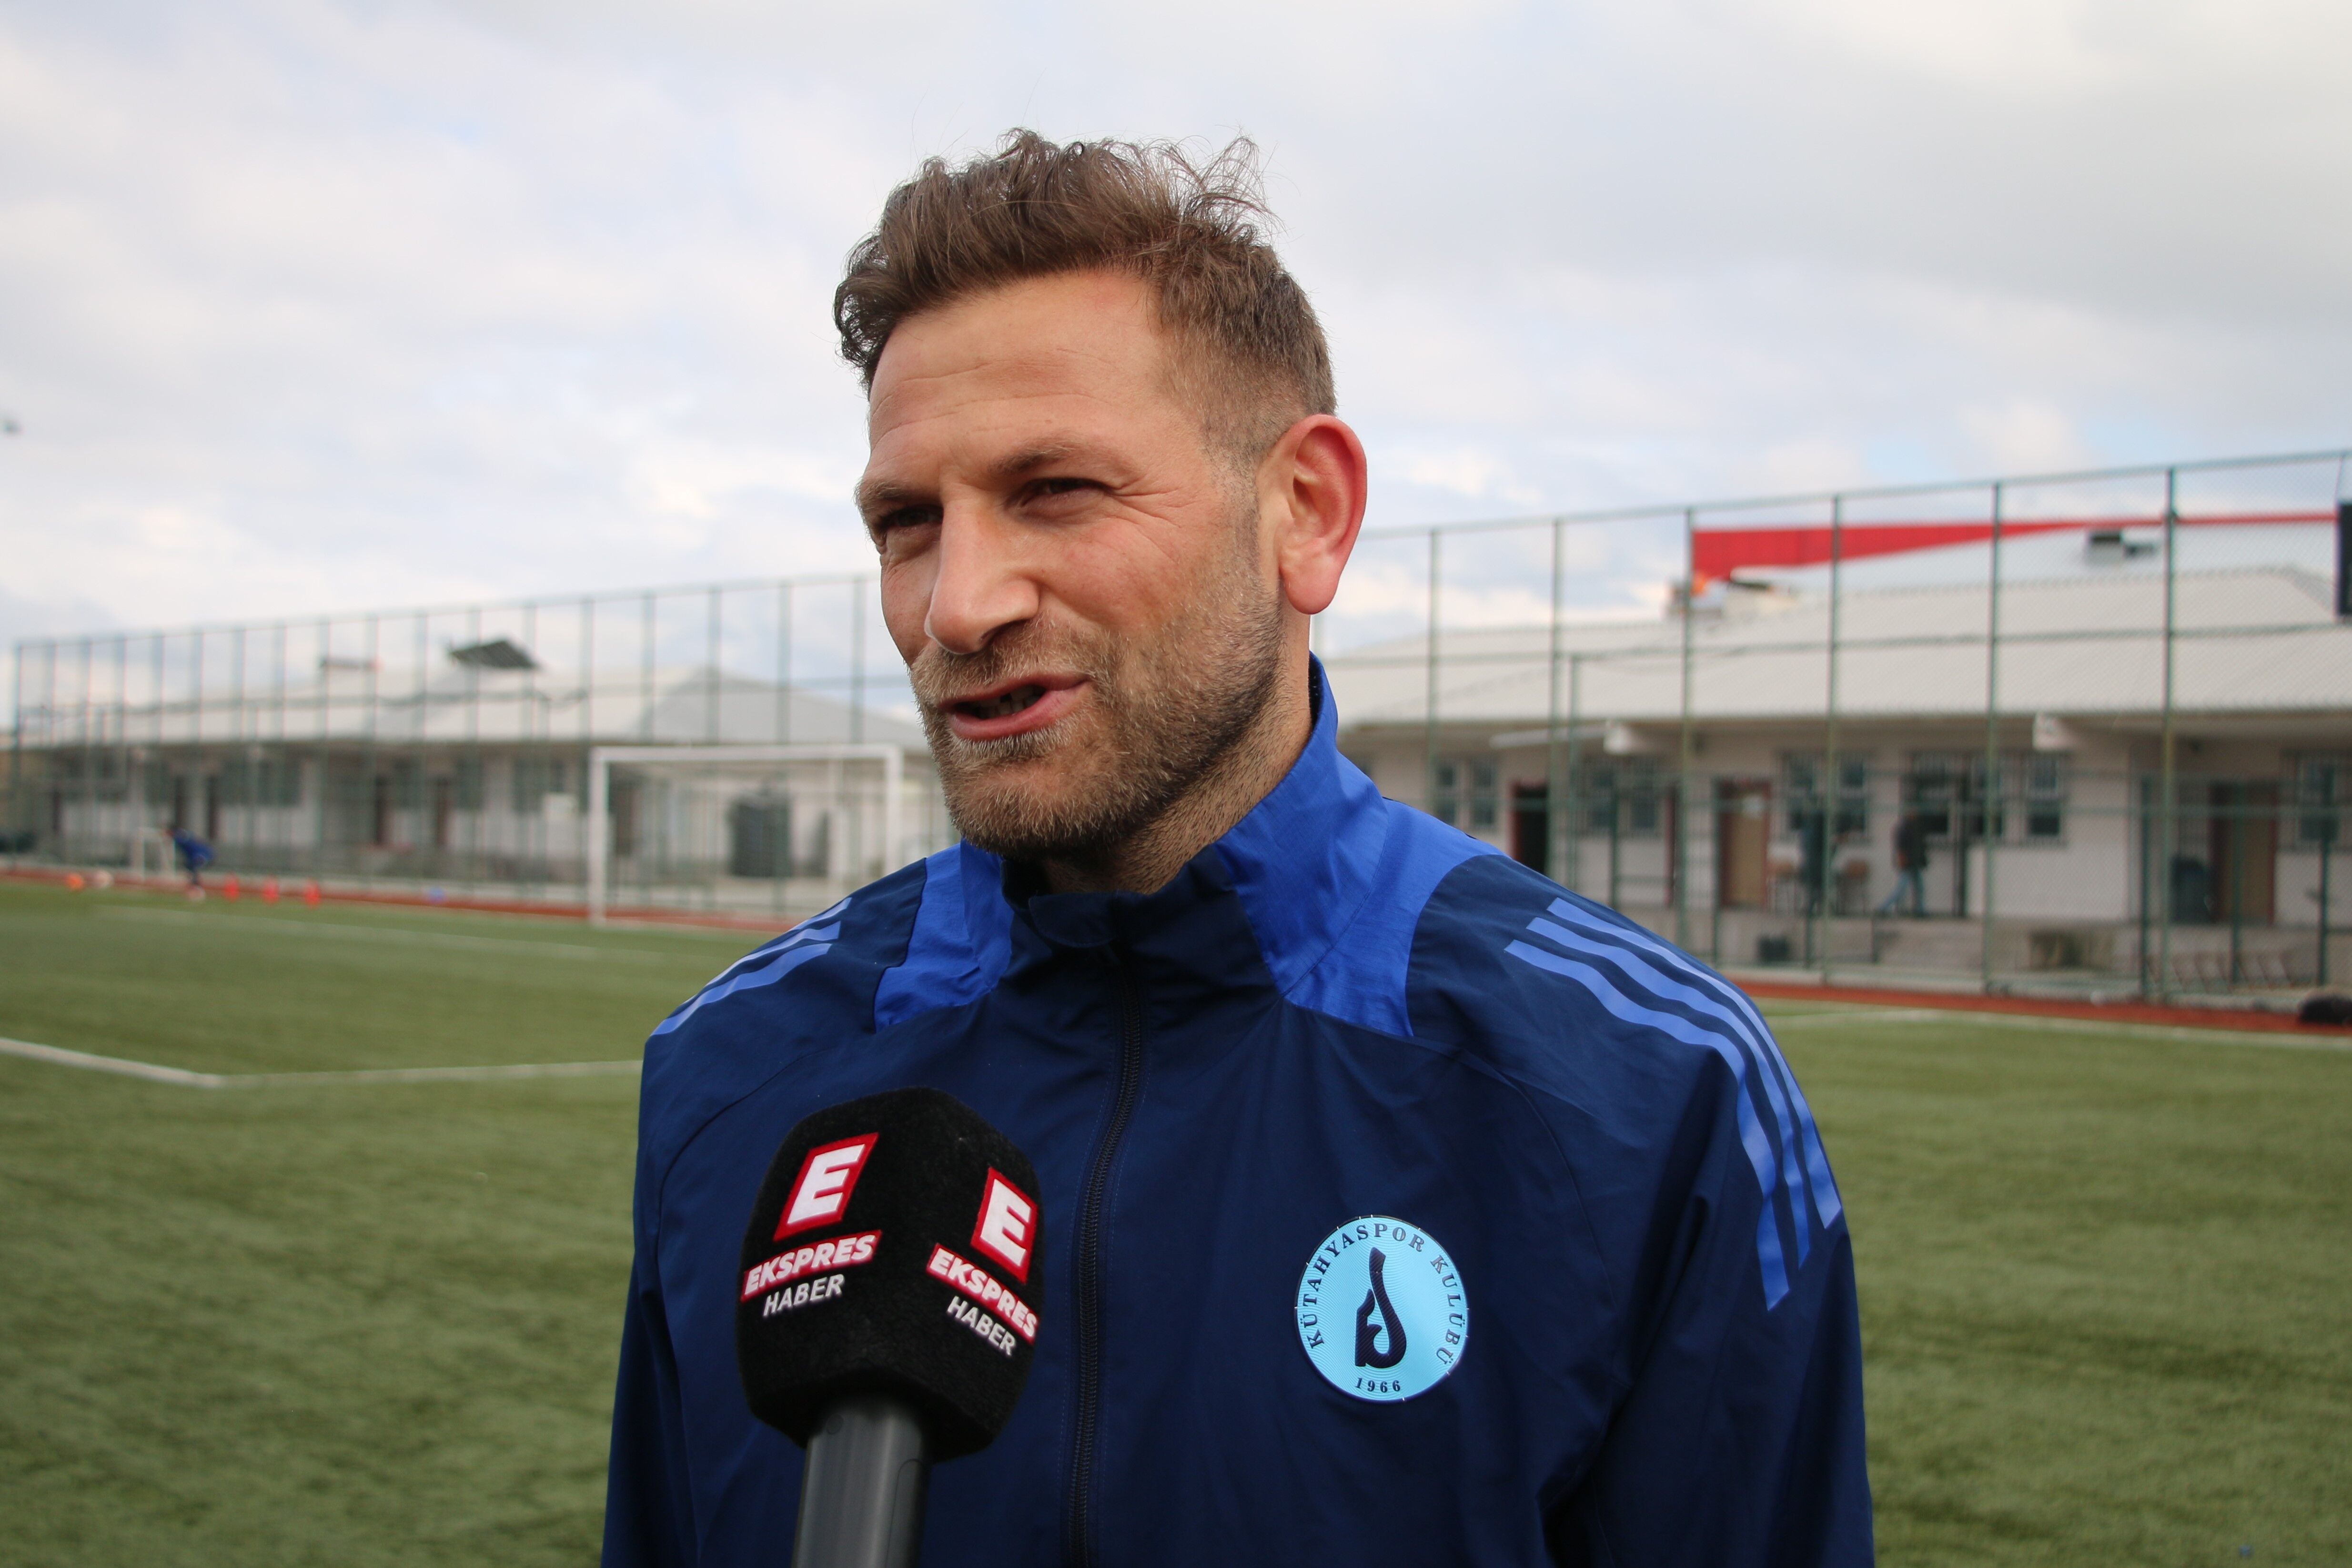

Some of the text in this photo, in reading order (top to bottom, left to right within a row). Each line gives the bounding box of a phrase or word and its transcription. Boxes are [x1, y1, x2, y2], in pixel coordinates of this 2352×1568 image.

[787, 1143, 865, 1224] E
[979, 1178, 1031, 1267] E
[744, 1234, 877, 1296] EKSPRES
[763, 1274, 845, 1317] HABER
[928, 1248, 1039, 1338] EKSPRES
[1300, 1223, 1466, 1365] KÜTAHYASPOR KULÜBÜ
[947, 1296, 1017, 1356] HABER
[1355, 1377, 1401, 1393] 1966
